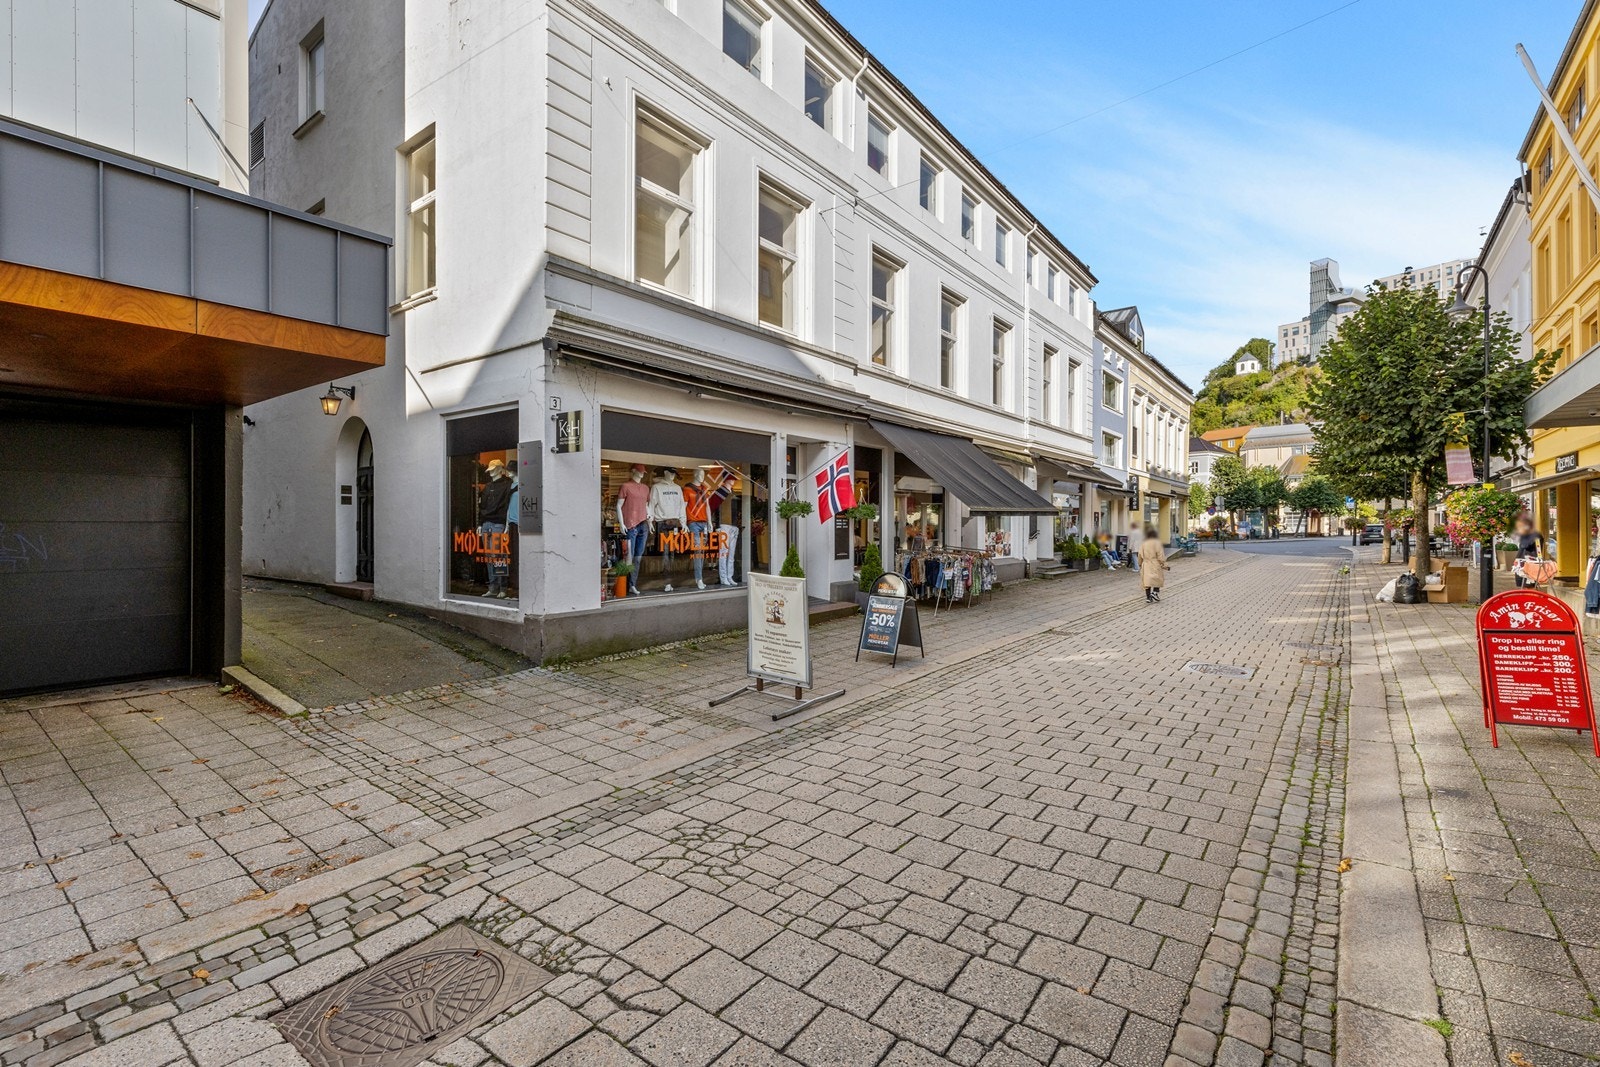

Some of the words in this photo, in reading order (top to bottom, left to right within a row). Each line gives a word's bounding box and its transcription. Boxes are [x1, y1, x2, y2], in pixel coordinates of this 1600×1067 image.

[552, 398, 558, 409] 3
[869, 612, 896, 628] -50%
[1489, 602, 1520, 623] Amin
[1524, 601, 1563, 623] Frisør
